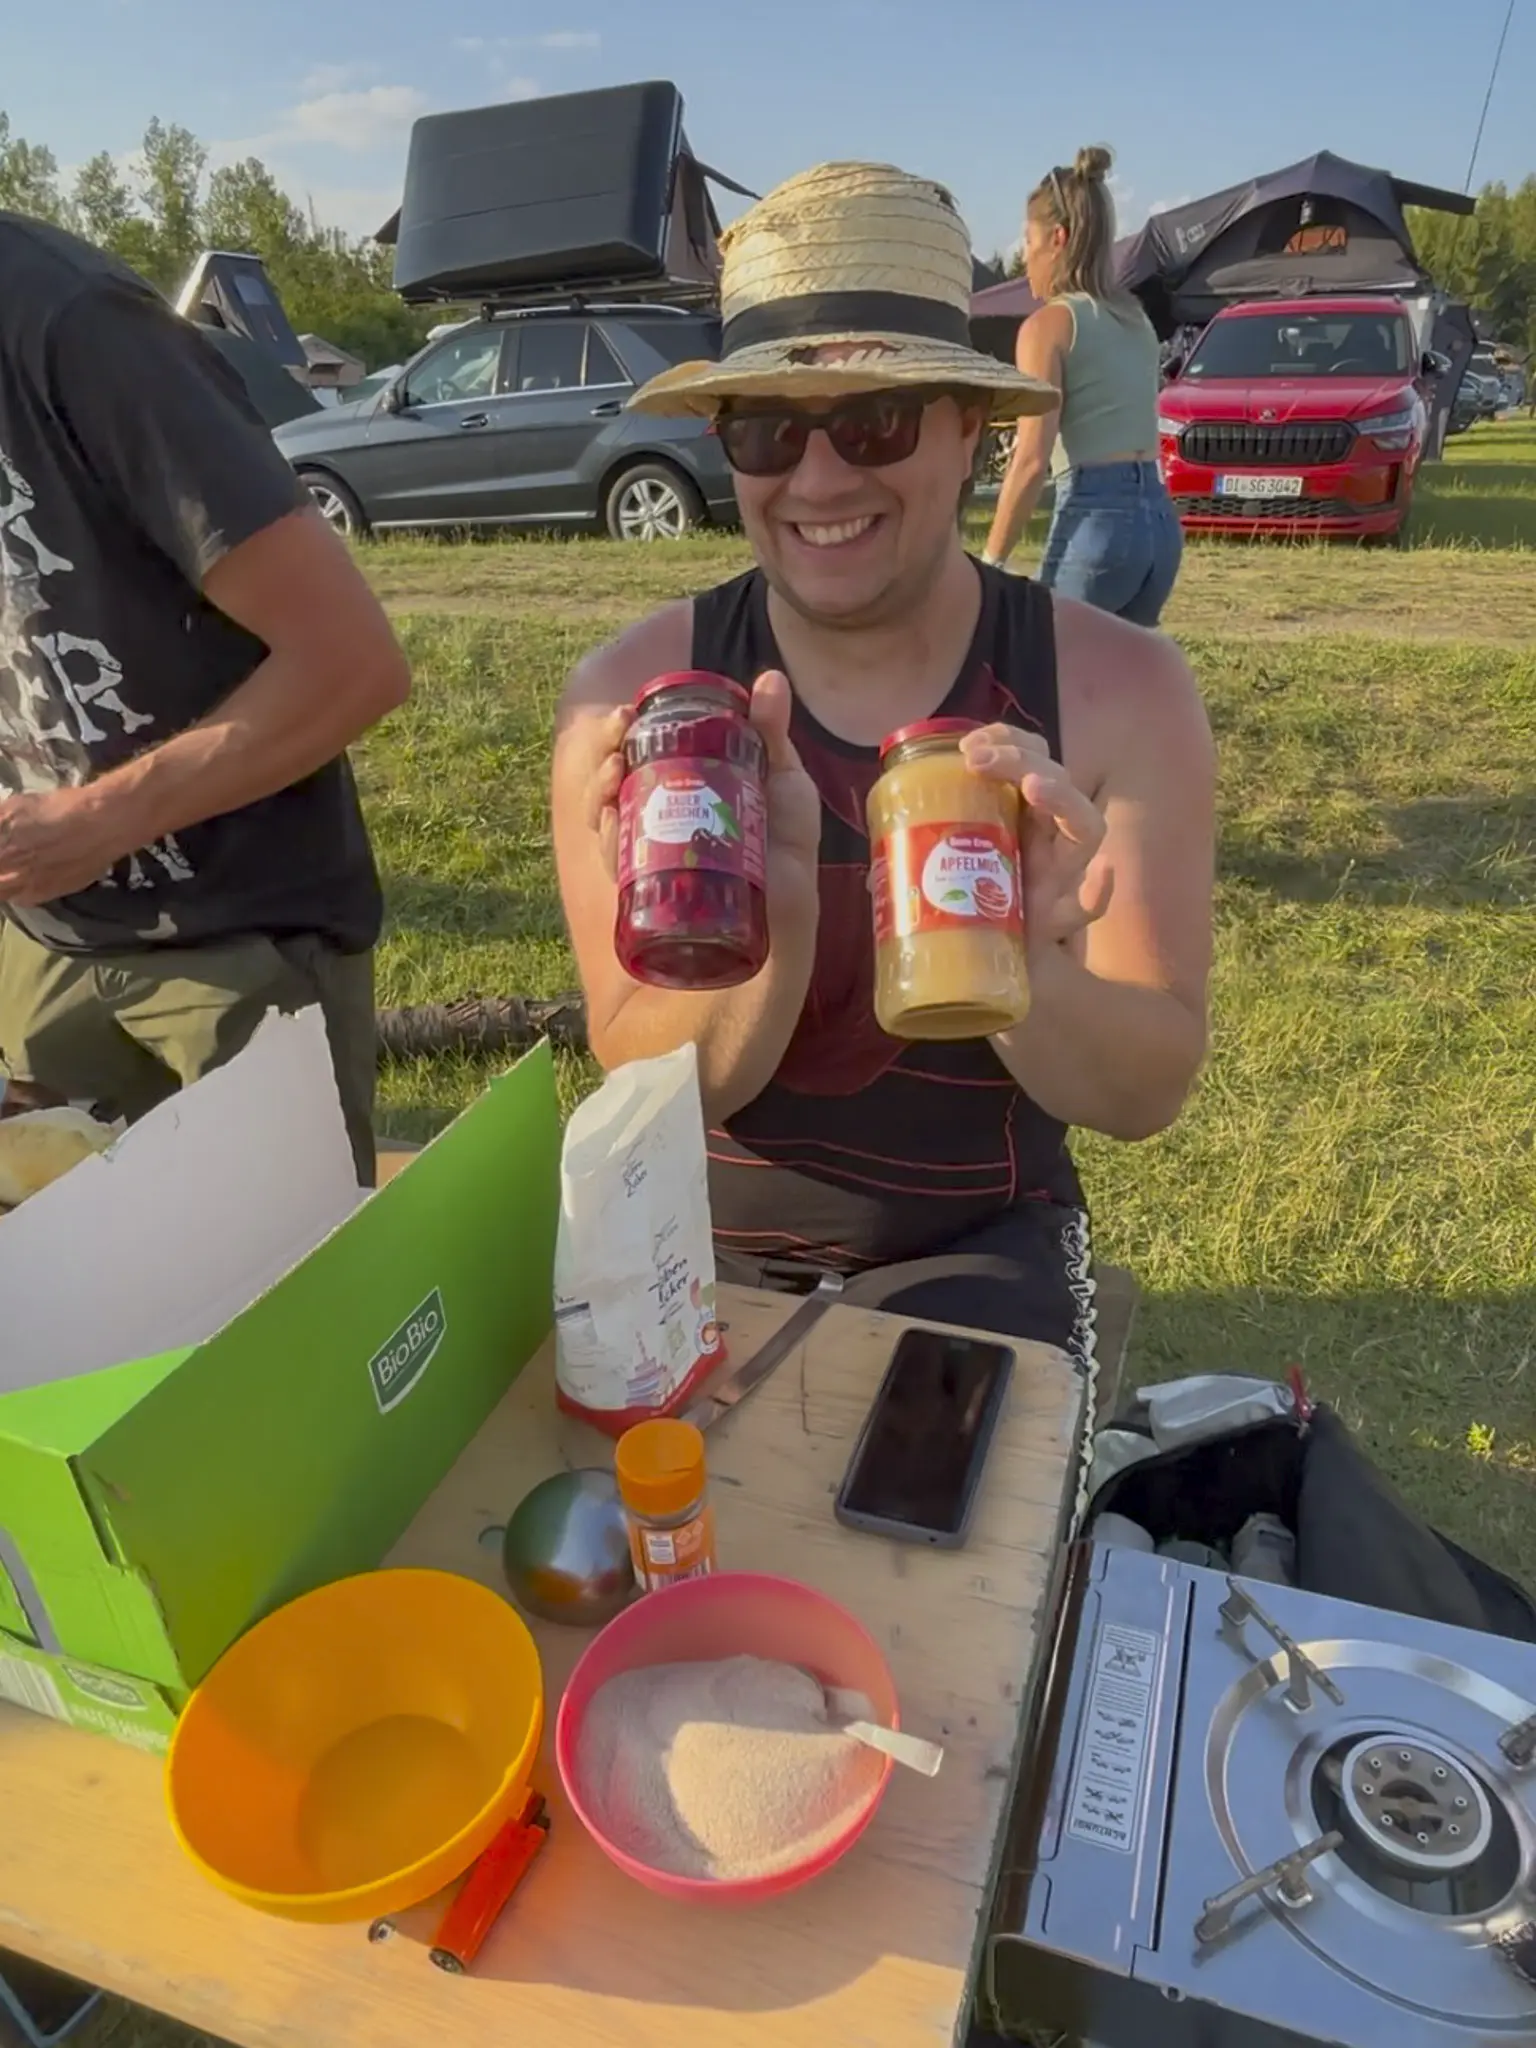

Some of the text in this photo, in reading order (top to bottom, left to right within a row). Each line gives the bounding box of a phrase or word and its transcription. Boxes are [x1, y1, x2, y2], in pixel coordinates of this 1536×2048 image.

[658, 807, 709, 820] KIRSCHEN
[939, 855, 1000, 875] APFELMUS
[377, 1309, 438, 1386] BioBio
